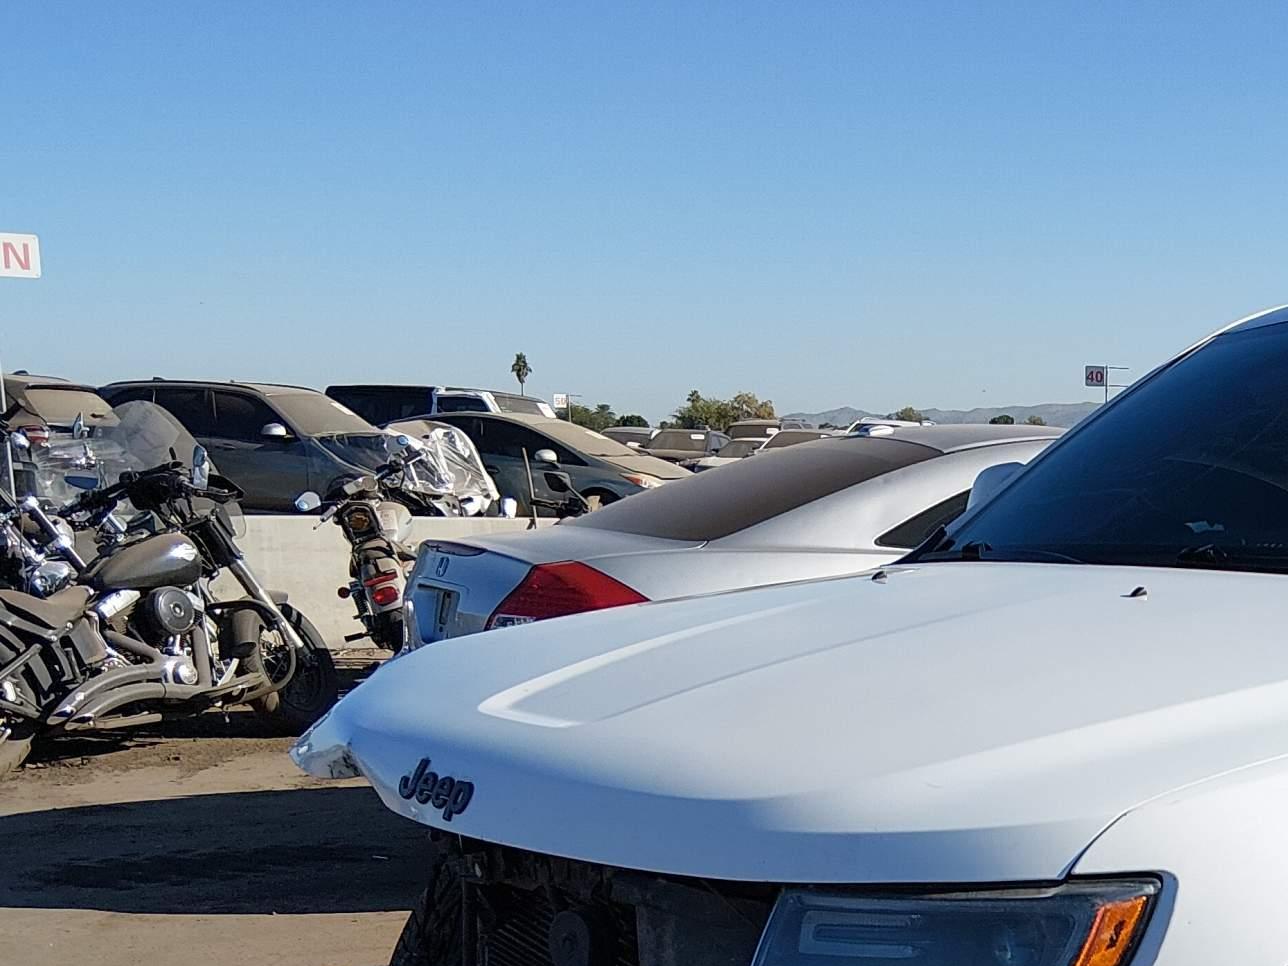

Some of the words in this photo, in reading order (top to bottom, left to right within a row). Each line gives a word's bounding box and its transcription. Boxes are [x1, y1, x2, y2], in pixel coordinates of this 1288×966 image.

[2, 241, 31, 271] N
[1087, 370, 1104, 383] 40
[398, 757, 475, 822] Jeep
